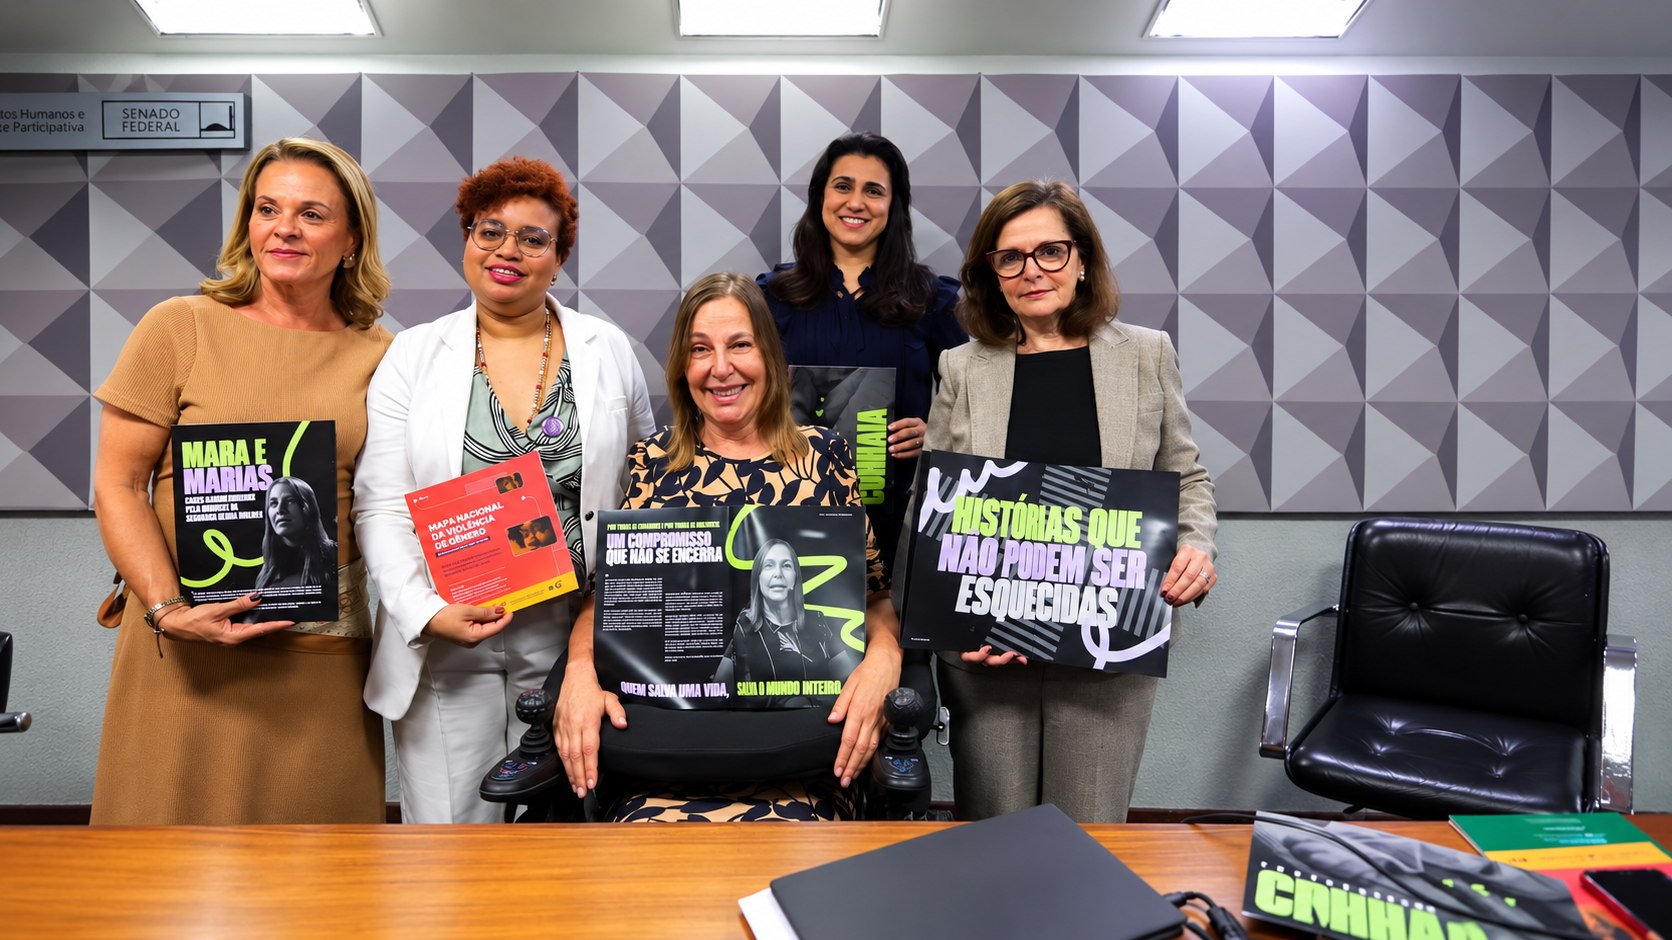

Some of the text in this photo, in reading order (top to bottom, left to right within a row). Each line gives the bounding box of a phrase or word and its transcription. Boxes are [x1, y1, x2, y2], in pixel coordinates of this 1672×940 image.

[20, 109, 75, 120] Humanos
[78, 111, 85, 120] e
[122, 108, 180, 119] SENADO
[13, 121, 84, 135] Participativa
[122, 121, 180, 132] FEDERAL
[181, 438, 267, 468] MARA E
[183, 464, 274, 495] MARIAS
[428, 501, 505, 533] MAPA NACIONAL
[951, 493, 1143, 549] HISTÓRIAS QUE
[431, 530, 446, 541] DA
[606, 531, 712, 548] UM COMPROMISSO
[434, 539, 449, 550] DE
[605, 546, 723, 567] QUE NÃO SE ENCERRA
[937, 529, 1147, 590] NÃO PODEM SER
[954, 574, 1119, 629] ESQUECIDAS
[620, 681, 730, 699] QUEM SALVA UMA VIDA,
[758, 681, 765, 696] O
[766, 680, 800, 696] MUNDO
